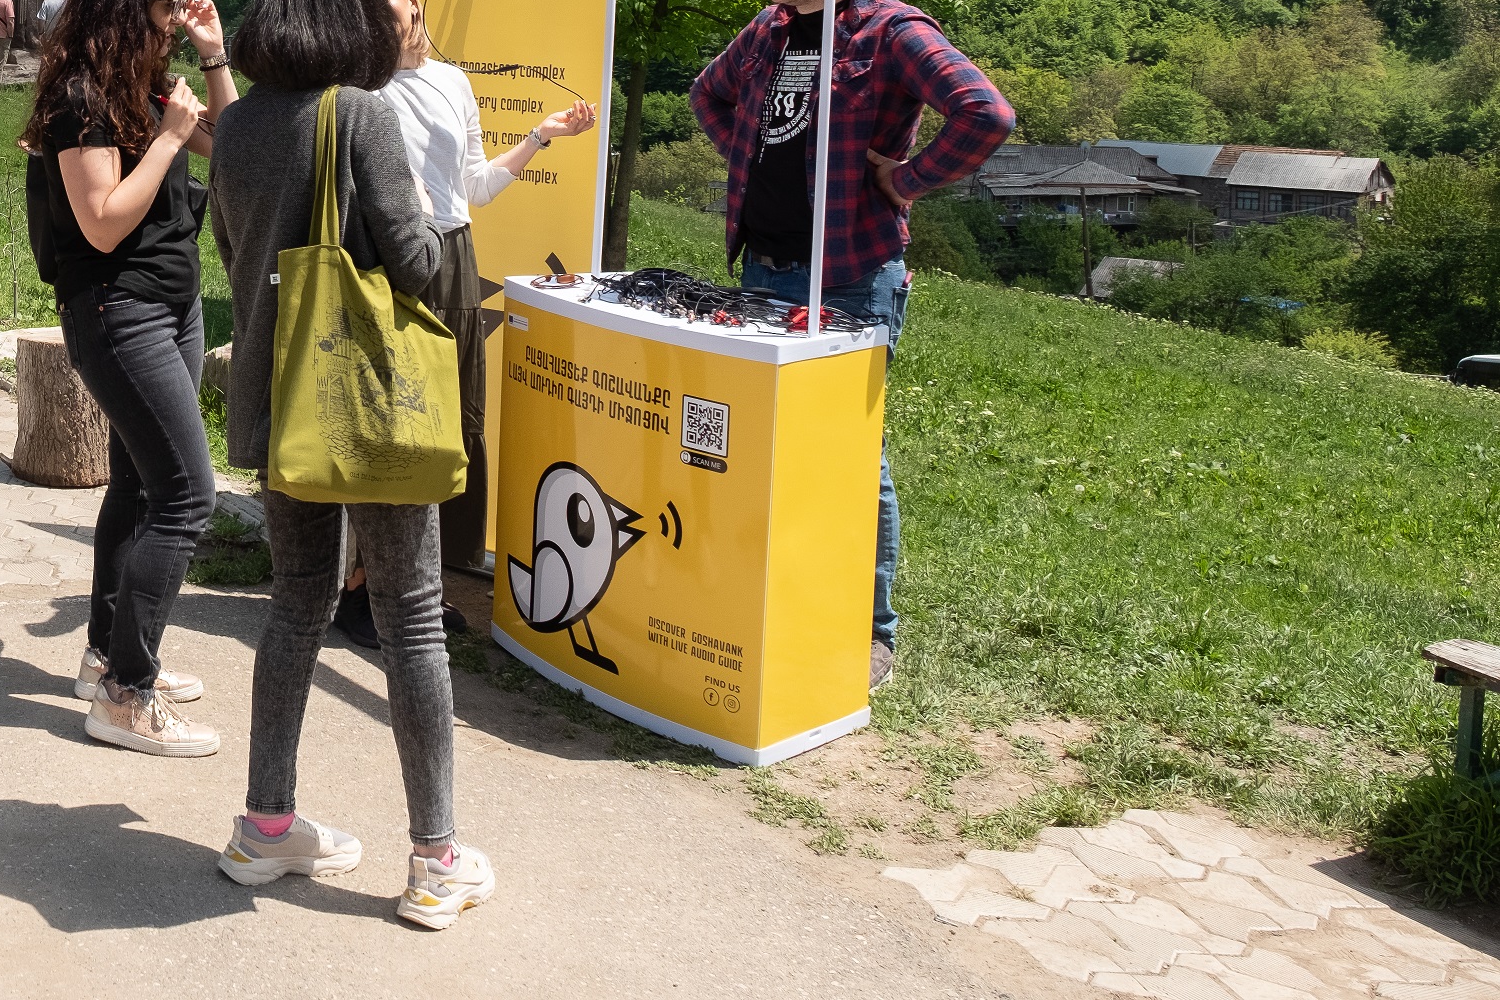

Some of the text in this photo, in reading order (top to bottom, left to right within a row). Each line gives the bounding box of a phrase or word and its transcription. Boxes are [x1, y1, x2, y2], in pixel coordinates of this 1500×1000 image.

[519, 63, 566, 82] complex
[500, 97, 544, 114] complex
[516, 168, 558, 186] omplex
[525, 345, 671, 408] ԲԱՑԱՀԱՅՏԵՔ ԳՈՇԱՎԱՆՔԸ
[508, 360, 670, 435] ԼԱՅՎ ԱՈՒԴԻՈ ԳԱՅԴԻ ՄԻՋՈՑՈՎ
[692, 456, 722, 470] SCAN ME
[648, 615, 743, 658] DISCOVER GOSHAVANK
[648, 630, 743, 673] WITH LIVE AUDIO GUIDE
[704, 675, 741, 694] FIND US
